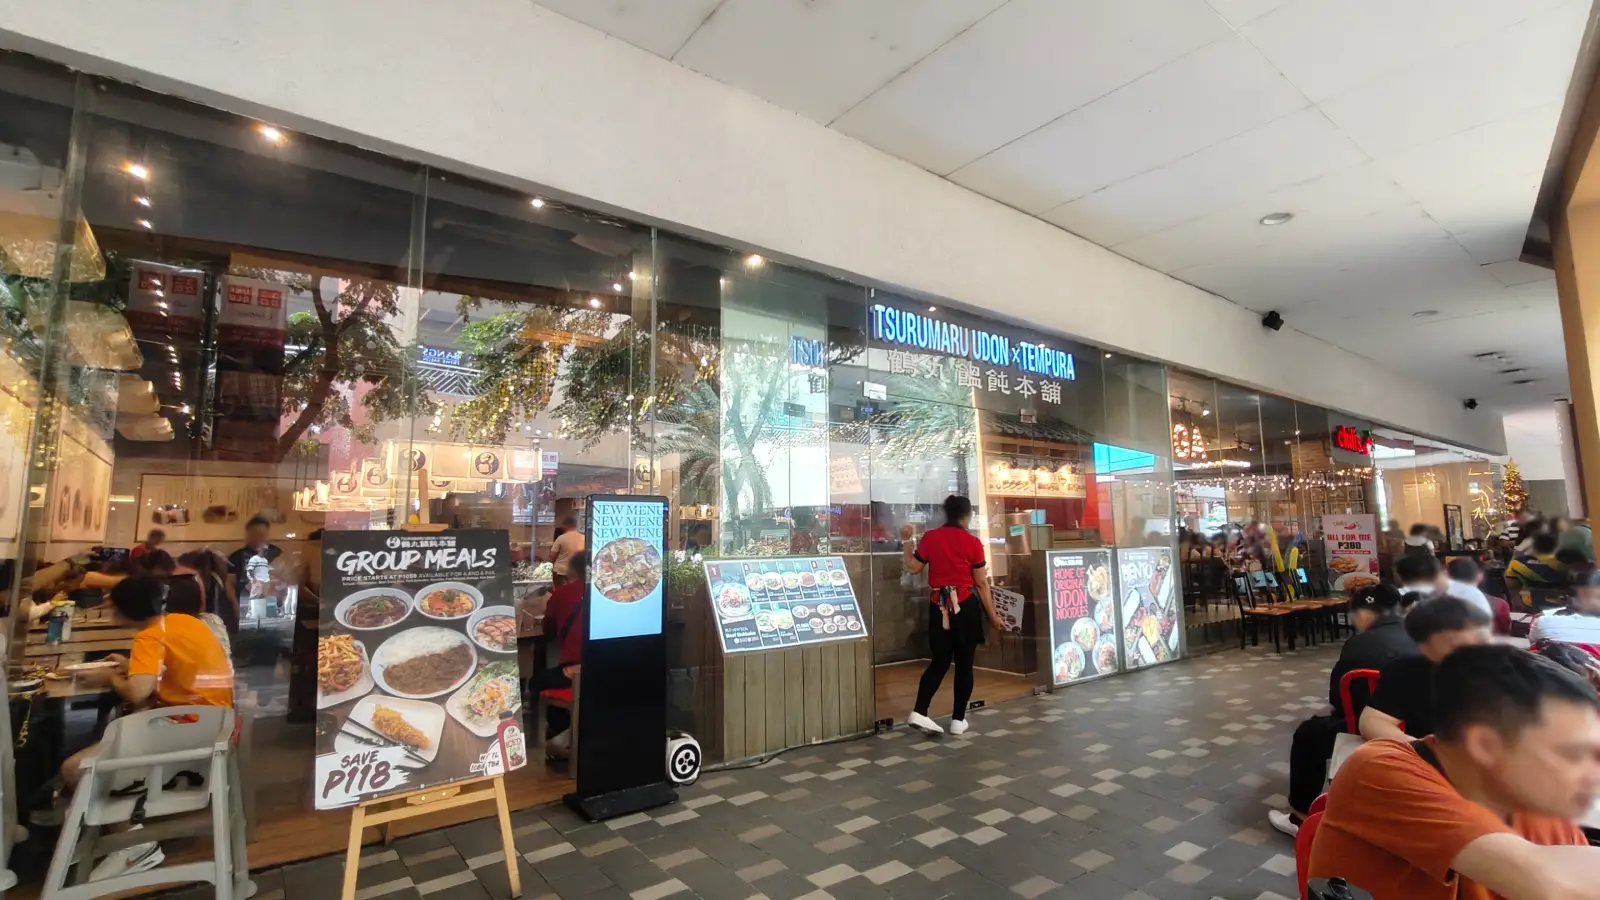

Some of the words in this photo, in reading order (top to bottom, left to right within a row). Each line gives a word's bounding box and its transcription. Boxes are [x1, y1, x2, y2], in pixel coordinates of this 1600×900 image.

[873, 304, 969, 356] TSURUMARU
[971, 329, 1010, 366] UDON
[1020, 341, 1076, 380] TEMPURA
[593, 504, 624, 515] NEW
[626, 505, 664, 516] MENU
[593, 516, 623, 526] NEW
[625, 517, 664, 527] MENU
[593, 527, 622, 538] NEW
[625, 528, 663, 538] MENU
[336, 550, 421, 575] GROUP
[424, 547, 497, 571] MEALS
[1053, 568, 1075, 579] HOME
[1076, 567, 1086, 578] OF
[1054, 577, 1087, 591] ORIGINAL
[1054, 588, 1088, 609] UDON
[1055, 605, 1089, 620] NOODLES
[340, 750, 379, 769] SAVE
[321, 760, 391, 799] P118
